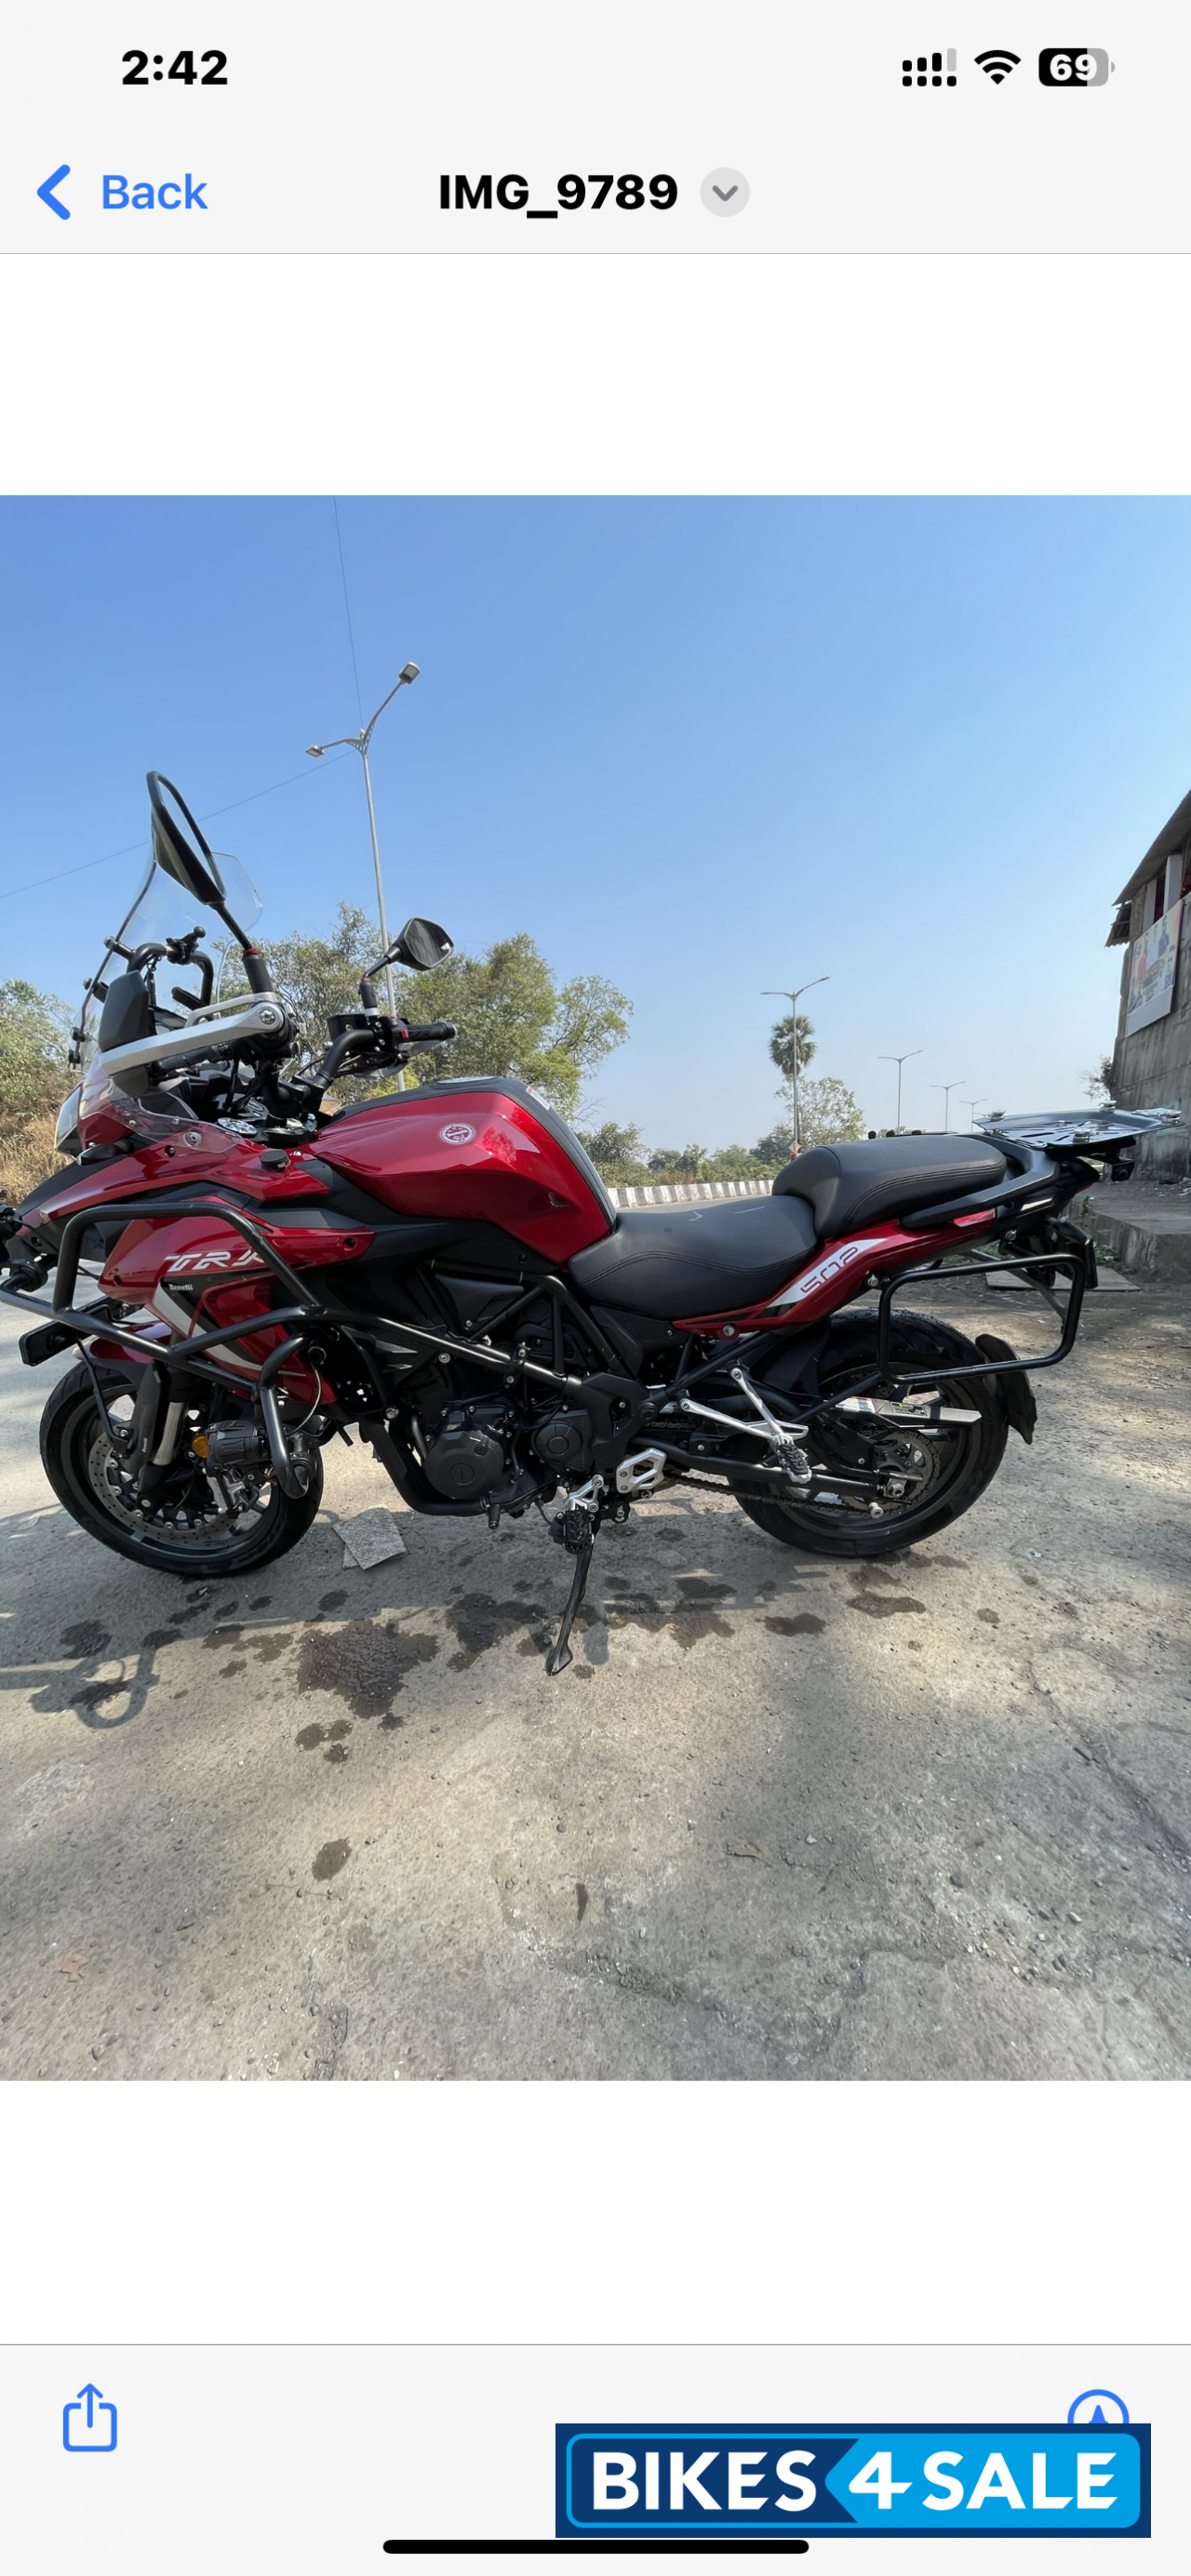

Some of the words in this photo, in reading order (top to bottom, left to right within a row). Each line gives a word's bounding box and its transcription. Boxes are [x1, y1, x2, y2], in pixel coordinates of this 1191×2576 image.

[121, 49, 228, 86] 2:42
[1050, 54, 1098, 81] 69
[101, 173, 208, 210] Back
[438, 173, 678, 220] IMG_9789
[800, 1247, 858, 1293] 502
